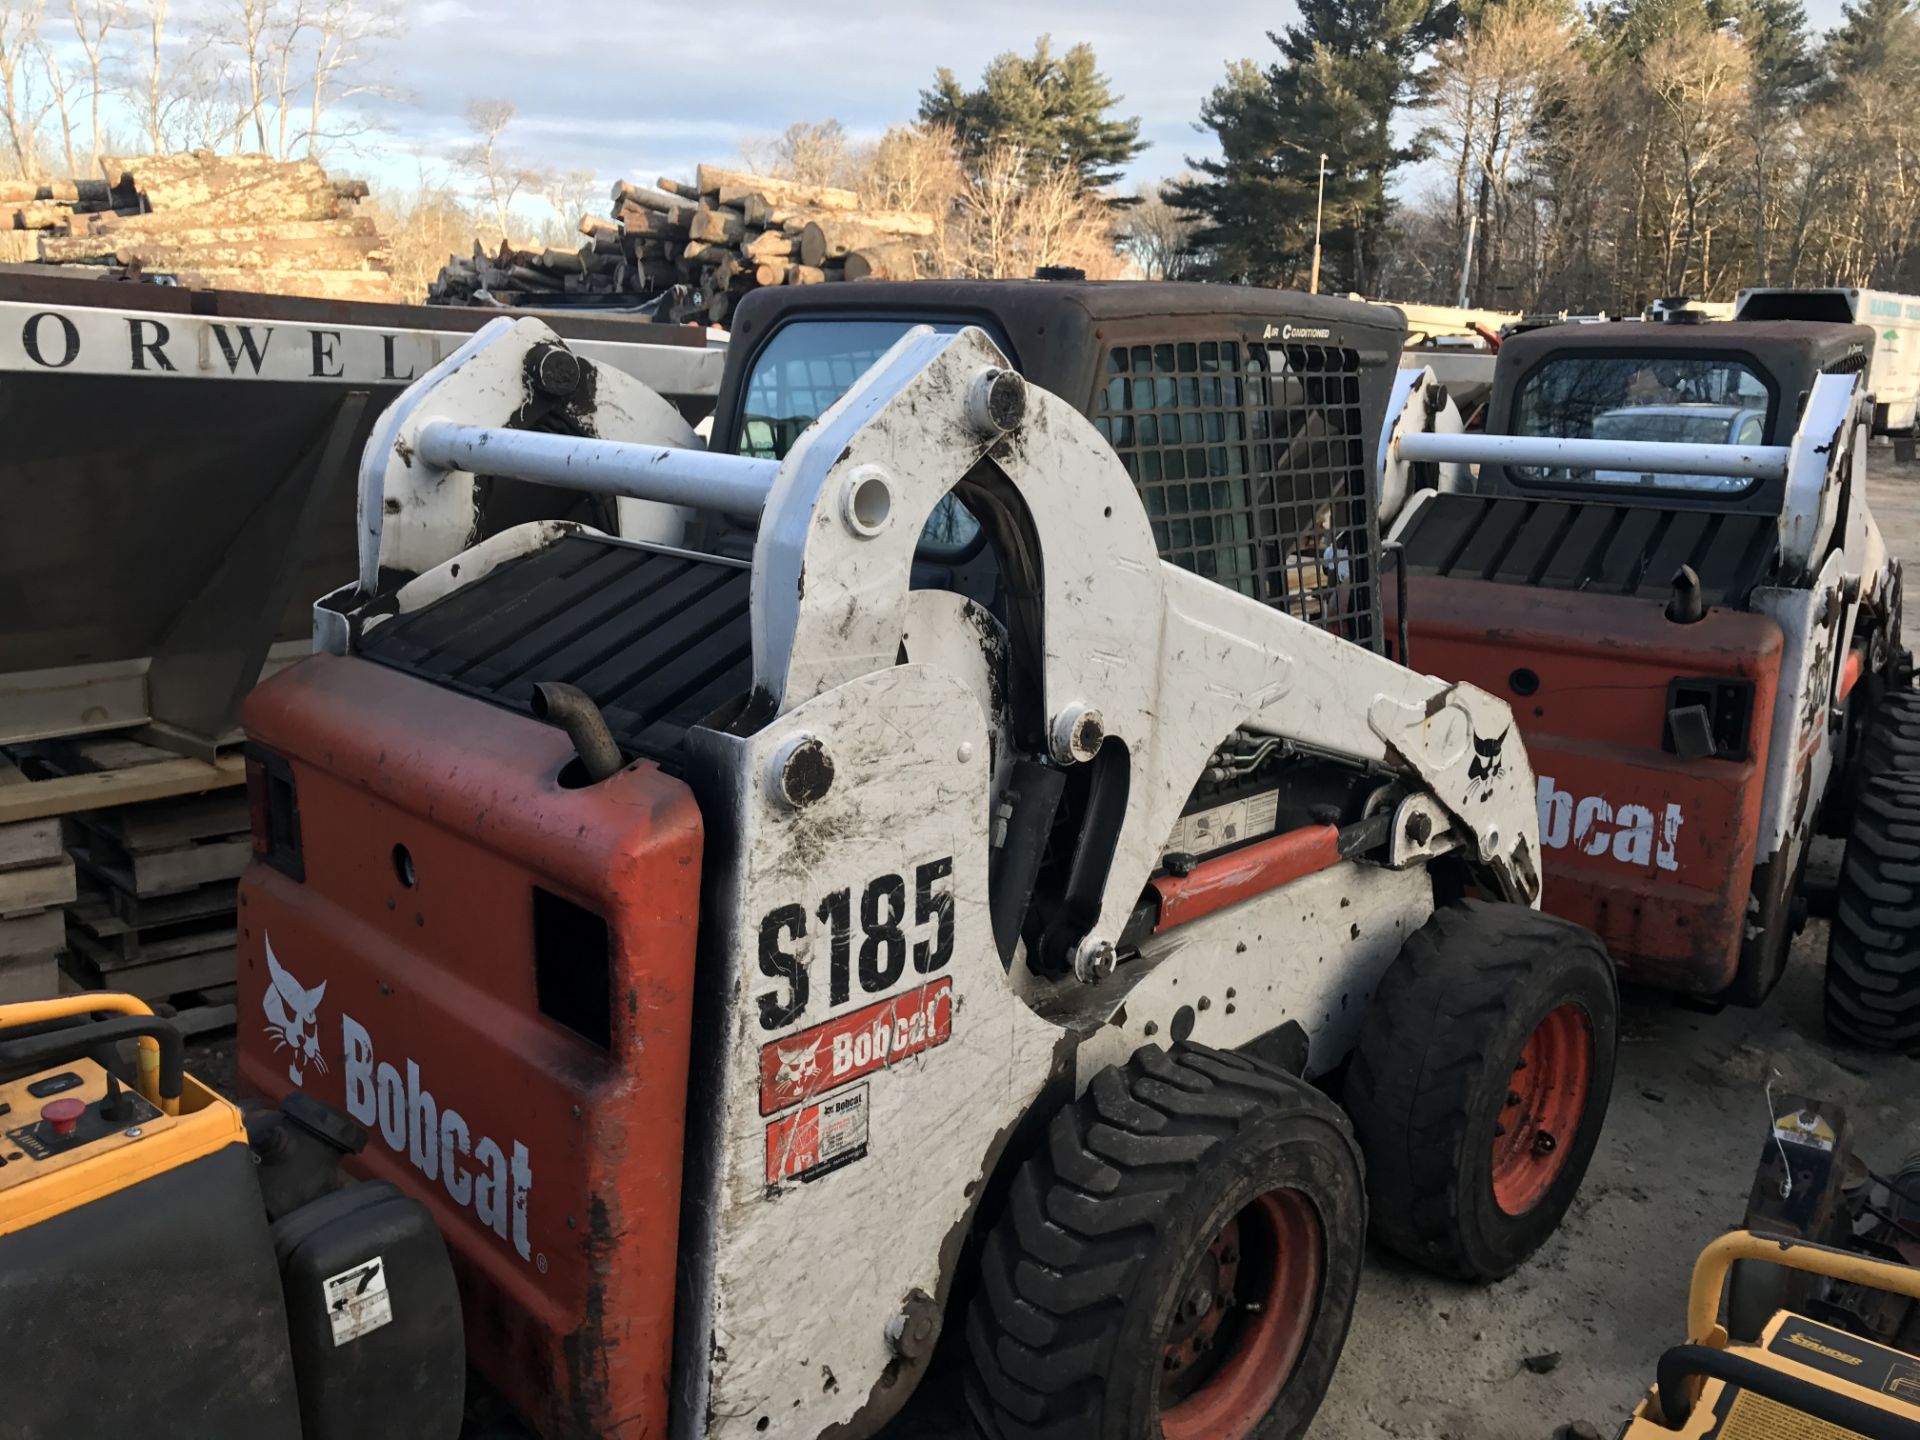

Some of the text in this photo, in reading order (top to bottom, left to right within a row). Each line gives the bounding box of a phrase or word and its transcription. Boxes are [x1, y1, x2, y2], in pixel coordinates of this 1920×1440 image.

[1536, 775, 1685, 872] bcat
[756, 855, 955, 1031] S185
[832, 1000, 937, 1077] Bobcat
[343, 1013, 532, 1262] Bobcat
[836, 1093, 863, 1113] Bobcat
